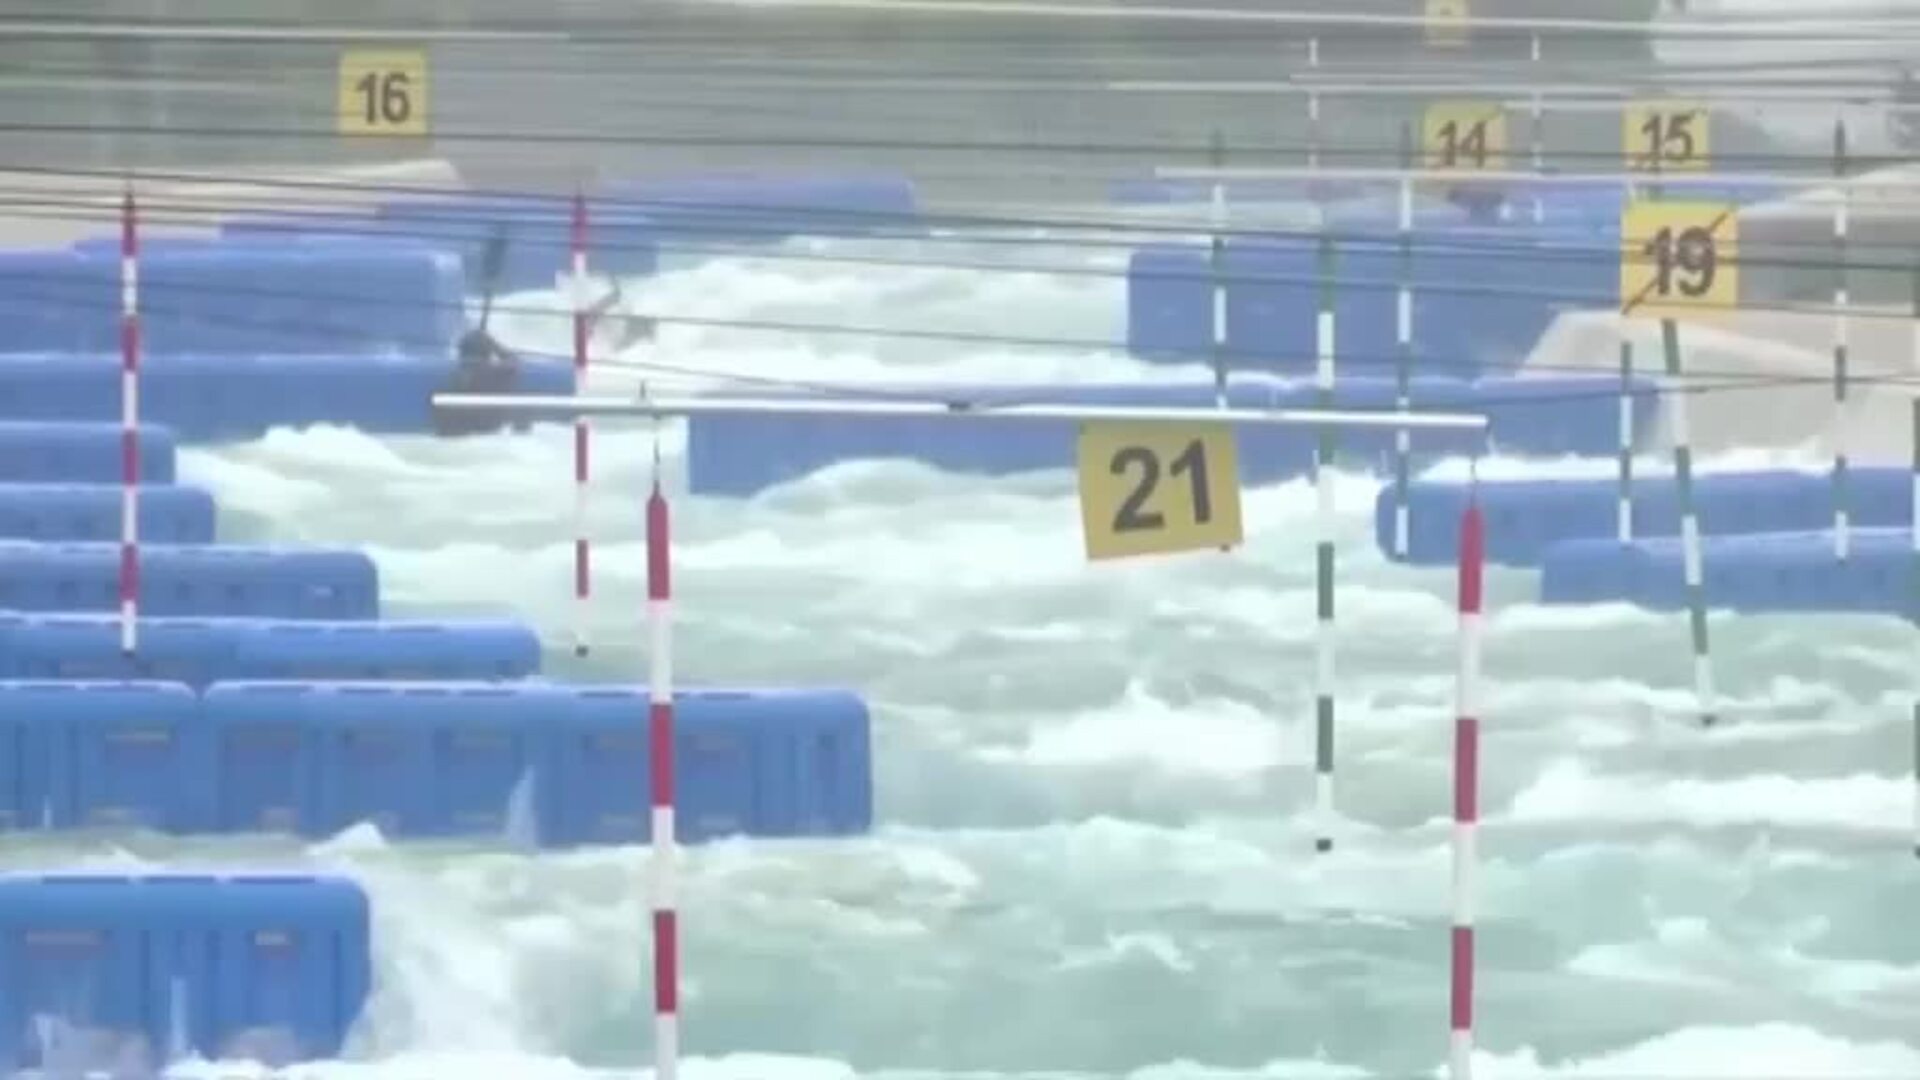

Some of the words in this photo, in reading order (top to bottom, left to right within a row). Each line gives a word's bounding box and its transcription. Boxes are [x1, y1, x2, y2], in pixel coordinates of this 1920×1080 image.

[355, 71, 410, 125] 16
[1436, 119, 1486, 170] 14
[1641, 113, 1694, 165] 15
[1643, 225, 1715, 297] 19
[1109, 438, 1211, 534] 21
